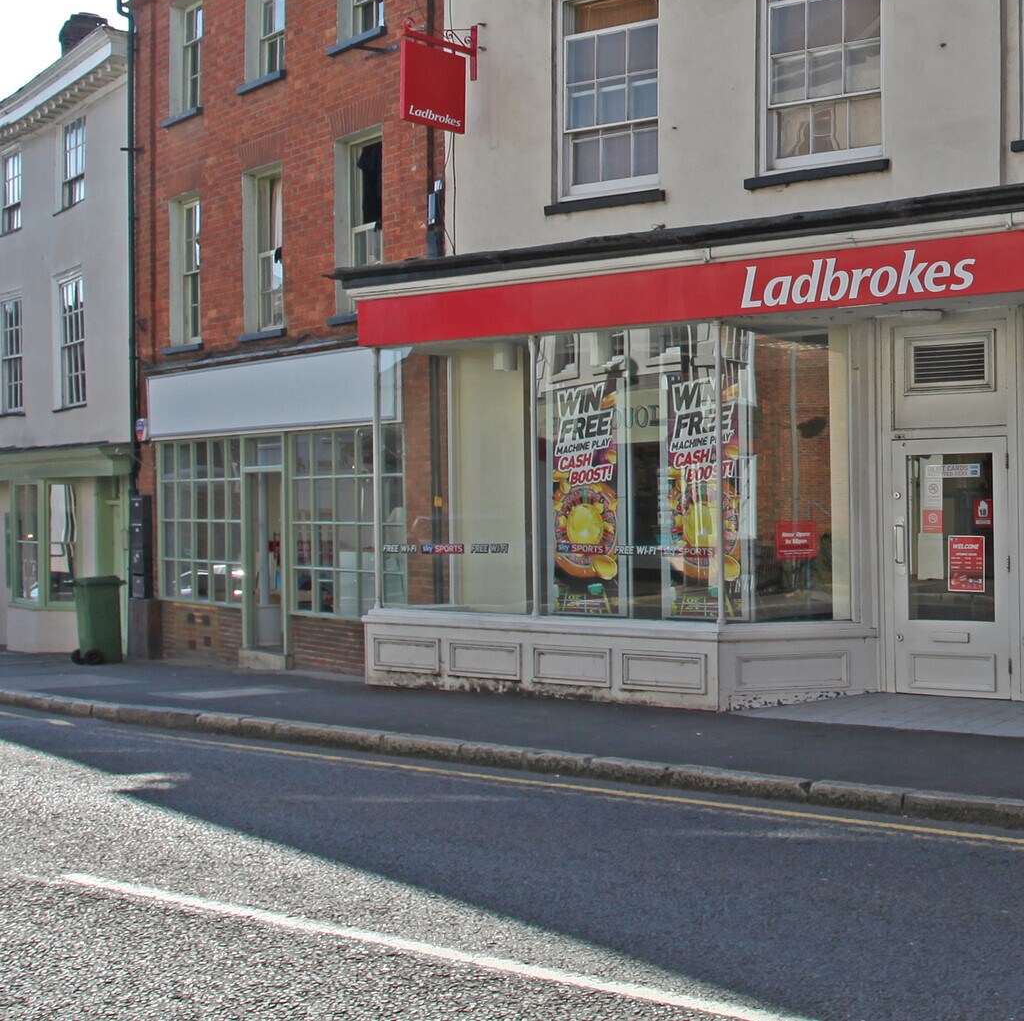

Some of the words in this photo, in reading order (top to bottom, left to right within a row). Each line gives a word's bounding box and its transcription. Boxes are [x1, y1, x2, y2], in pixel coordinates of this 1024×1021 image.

[409, 105, 461, 127] Ladbrokes
[740, 249, 976, 309] Ladbrokes
[559, 384, 602, 415] WIN
[673, 379, 716, 412] WIN
[560, 411, 612, 443] FREE
[675, 405, 733, 439] FREE
[556, 440, 591, 455] MACHINE
[671, 438, 708, 452] MACHINE
[560, 453, 592, 470] CASH
[676, 449, 711, 467] CASH
[570, 465, 613, 484] BOOST!
[979, 508, 987, 516] 18
[383, 544, 399, 553] FREE
[422, 544, 433, 554] sky
[434, 544, 464, 554] SPORTS
[470, 544, 489, 554] FREE
[557, 544, 569, 553] sky
[572, 544, 604, 554] SPORTS
[615, 545, 634, 555] FREE
[679, 547, 713, 557] SPORTS
